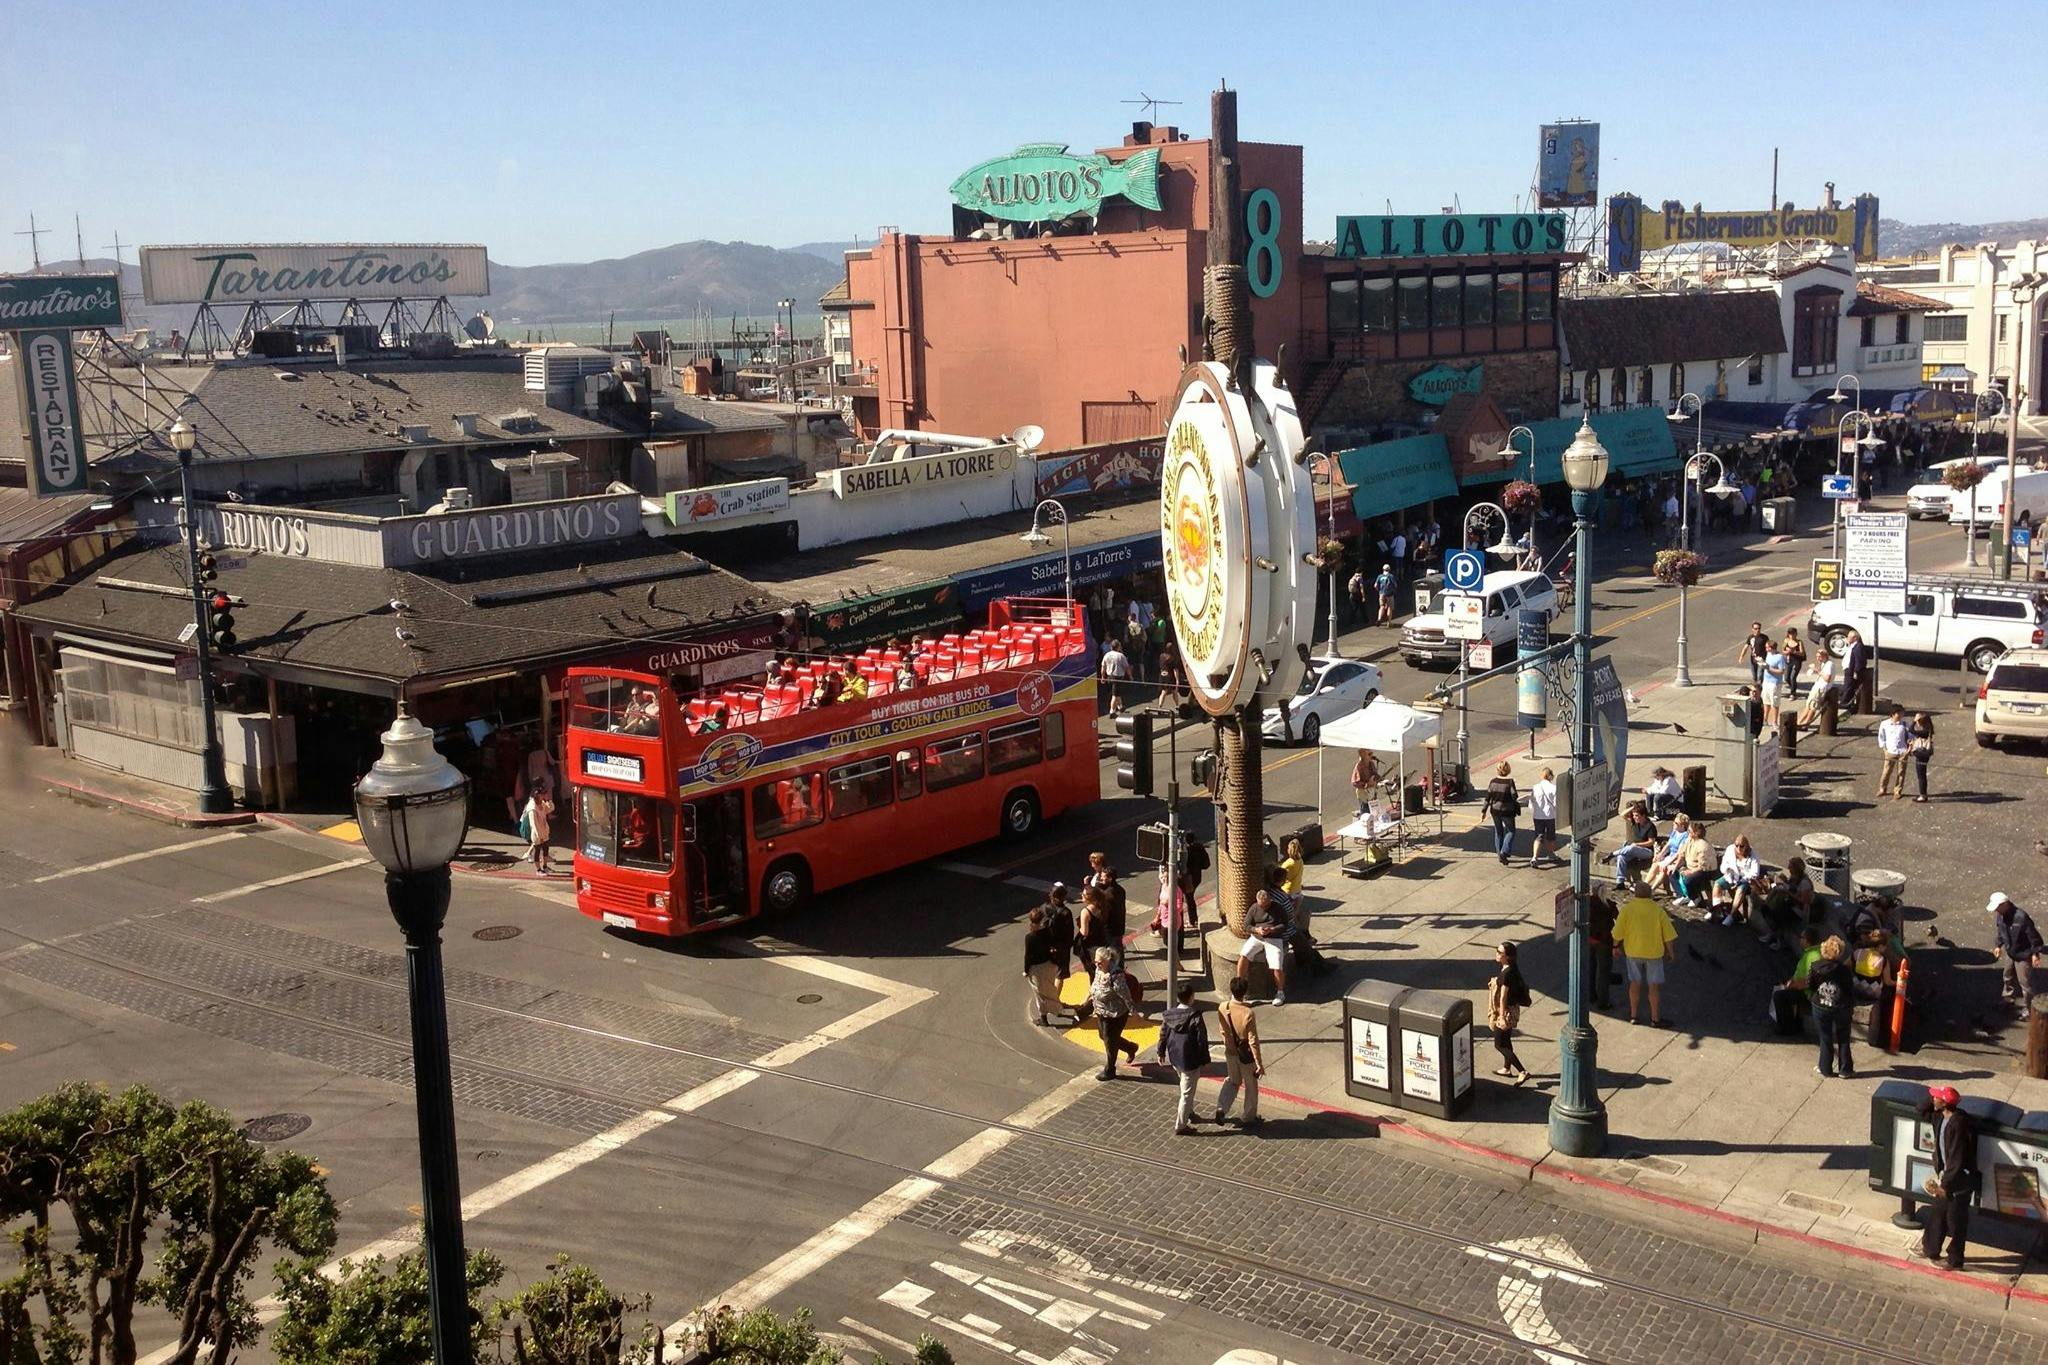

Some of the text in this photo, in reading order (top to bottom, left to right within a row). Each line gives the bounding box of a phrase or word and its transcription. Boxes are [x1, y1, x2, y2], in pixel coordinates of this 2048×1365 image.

[1546, 138, 1558, 155] 9
[979, 165, 1103, 204] ALIOTO'S
[1339, 215, 1566, 257] ALIOTO'S
[1612, 201, 1640, 268] 9
[1662, 200, 1838, 240] Fishermen's Grotto
[1246, 188, 1283, 298] 8
[194, 251, 457, 300] Tarantino's
[0, 284, 117, 319] rantino's
[36, 344, 71, 481] RESTAURANT
[847, 468, 911, 493] SABELLA
[926, 463, 944, 481] LA
[948, 453, 994, 478] TORRE
[1041, 453, 1100, 494] LIGHT
[720, 484, 780, 515] Crab Station
[411, 501, 621, 559] GUARDINO'S
[1032, 561, 1068, 581] Sabella
[1074, 561, 1083, 571] &
[1087, 547, 1132, 569] LaTorre's
[1079, 570, 1111, 585] RESTAURANT
[1456, 558, 1474, 582] P
[1848, 568, 1881, 578] $3.00
[849, 599, 896, 626] Crab Station
[648, 638, 740, 671] GUARDINO'S
[1020, 675, 1044, 693] VALID FOR
[1031, 687, 1039, 701] 2
[1605, 687, 1623, 702] YEARS
[871, 685, 990, 720] BUY TICKET ON THE BUS FOR
[1030, 697, 1046, 711] DAYS
[829, 731, 851, 747] CITY
[853, 724, 882, 741] TOUR
[891, 715, 931, 732] GOLDEN
[933, 709, 957, 724] GATE
[696, 761, 718, 775] HOP ON
[739, 748, 750, 758] HOP
[1582, 791, 1600, 811] MUST
